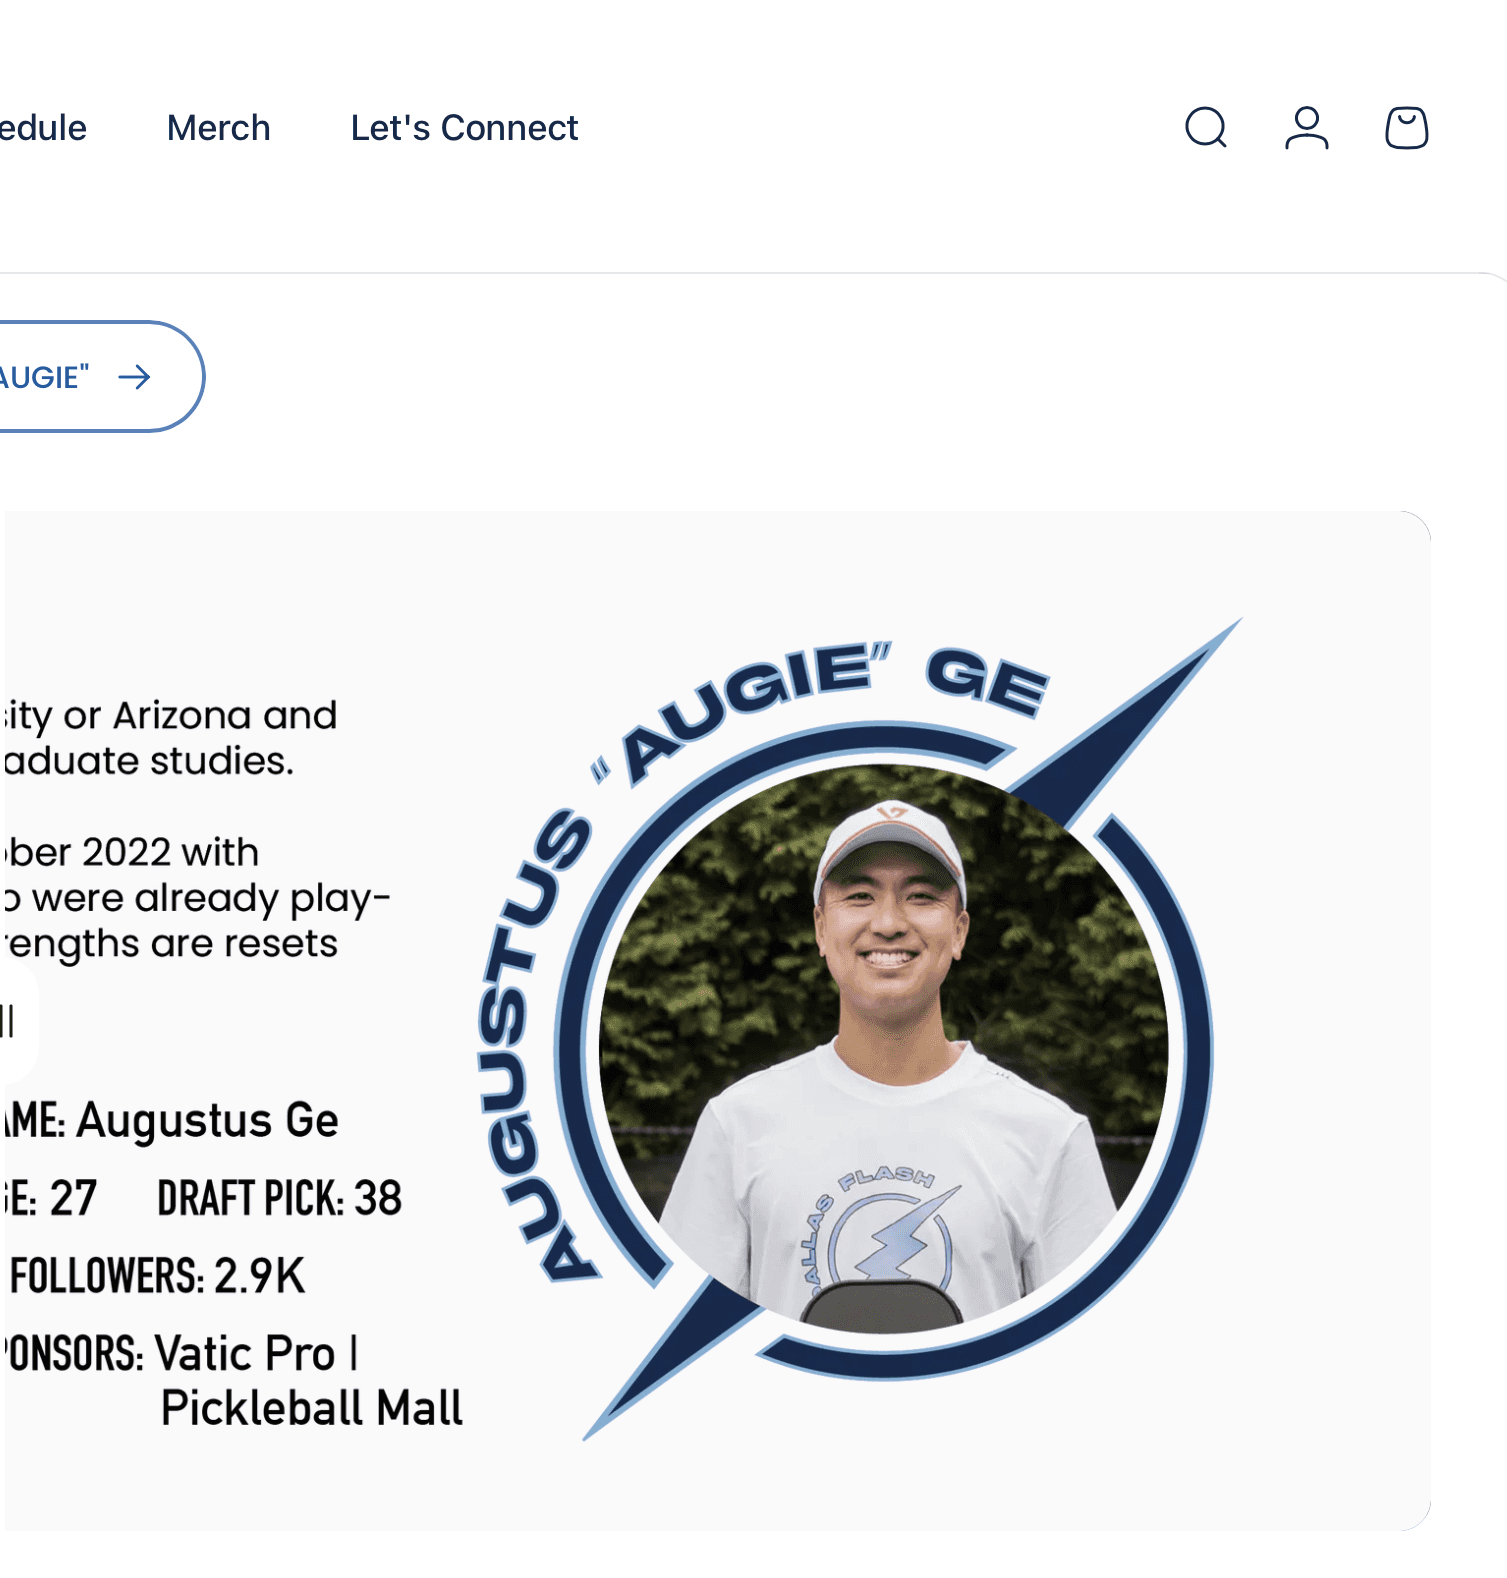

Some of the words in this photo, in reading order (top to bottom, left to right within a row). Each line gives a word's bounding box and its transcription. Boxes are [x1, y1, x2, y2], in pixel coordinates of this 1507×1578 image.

[169, 113, 269, 141] Merch
[353, 114, 430, 141] Let's
[442, 114, 578, 141] Connect
[5, 699, 53, 739] ity
[64, 706, 101, 729] or
[113, 699, 250, 730] Arizona
[264, 699, 336, 730] and
[5, 745, 139, 775] aduate
[151, 745, 293, 775] studies.
[5, 837, 71, 867] ber
[83, 836, 171, 867] 2022
[181, 836, 258, 867] with
[32, 888, 123, 912] were
[135, 881, 279, 921] already
[292, 881, 390, 921] play-
[5, 927, 139, 967] engths
[152, 934, 213, 957] are
[226, 930, 337, 957] resets
[477, 808, 603, 1283] AUGUSTUS
[926, 647, 1051, 720] GE
[76, 1100, 271, 1148] Augustus
[287, 1100, 339, 1137] Ge
[838, 1165, 935, 1192] FLASH
[5, 1179, 37, 1216] E:
[50, 1179, 97, 1216] 27
[159, 1179, 256, 1216] DRAFT
[265, 1179, 344, 1216] PICK:
[354, 1179, 403, 1216] 38
[11, 1256, 204, 1294] FOLLOWERS:
[215, 1256, 306, 1294] 2.9K
[5, 1334, 144, 1371] ONSORS:
[153, 1334, 252, 1371] Vatic
[267, 1334, 335, 1371] Pro
[162, 1388, 364, 1425] Pickleball
[377, 1388, 464, 1425] Mall
